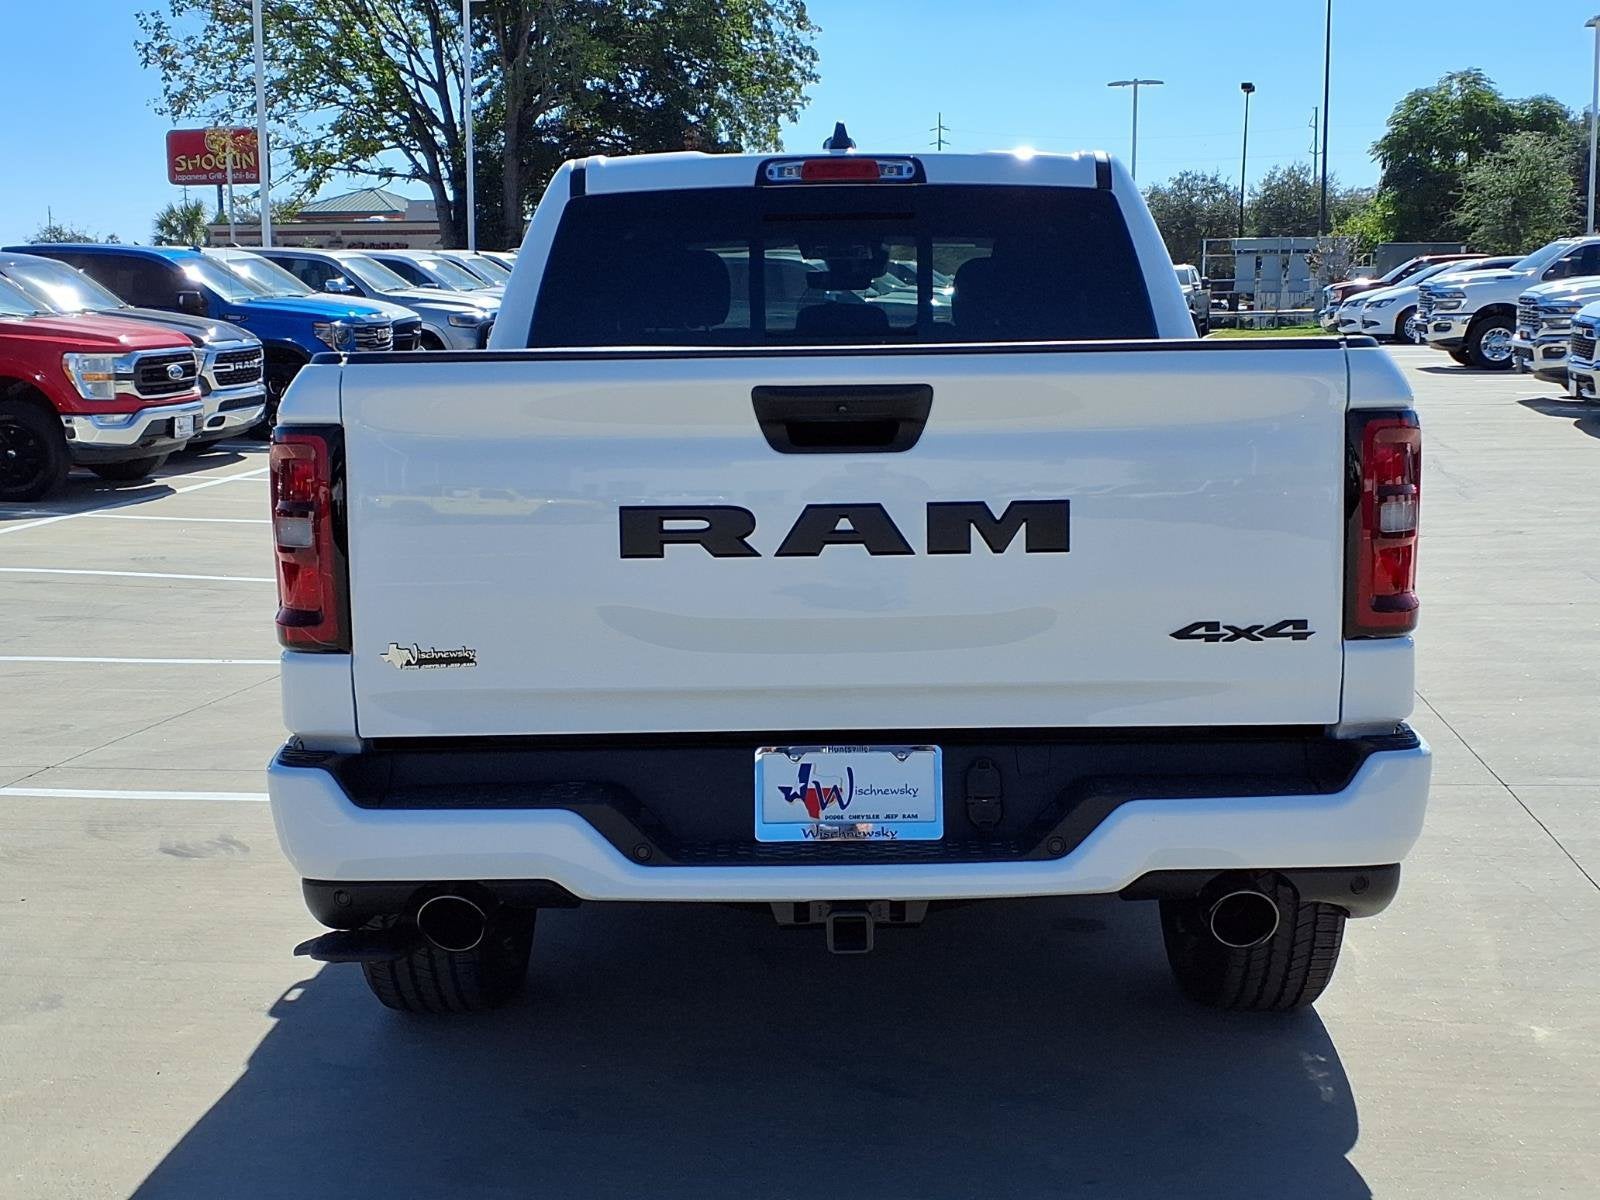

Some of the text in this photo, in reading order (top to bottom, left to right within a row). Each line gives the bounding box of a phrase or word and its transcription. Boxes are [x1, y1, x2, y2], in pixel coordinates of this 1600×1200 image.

[175, 173, 207, 181] Japanese
[619, 499, 1071, 559] RAM
[1169, 619, 1316, 642] 4x4
[801, 823, 898, 840] Wischnewsky
